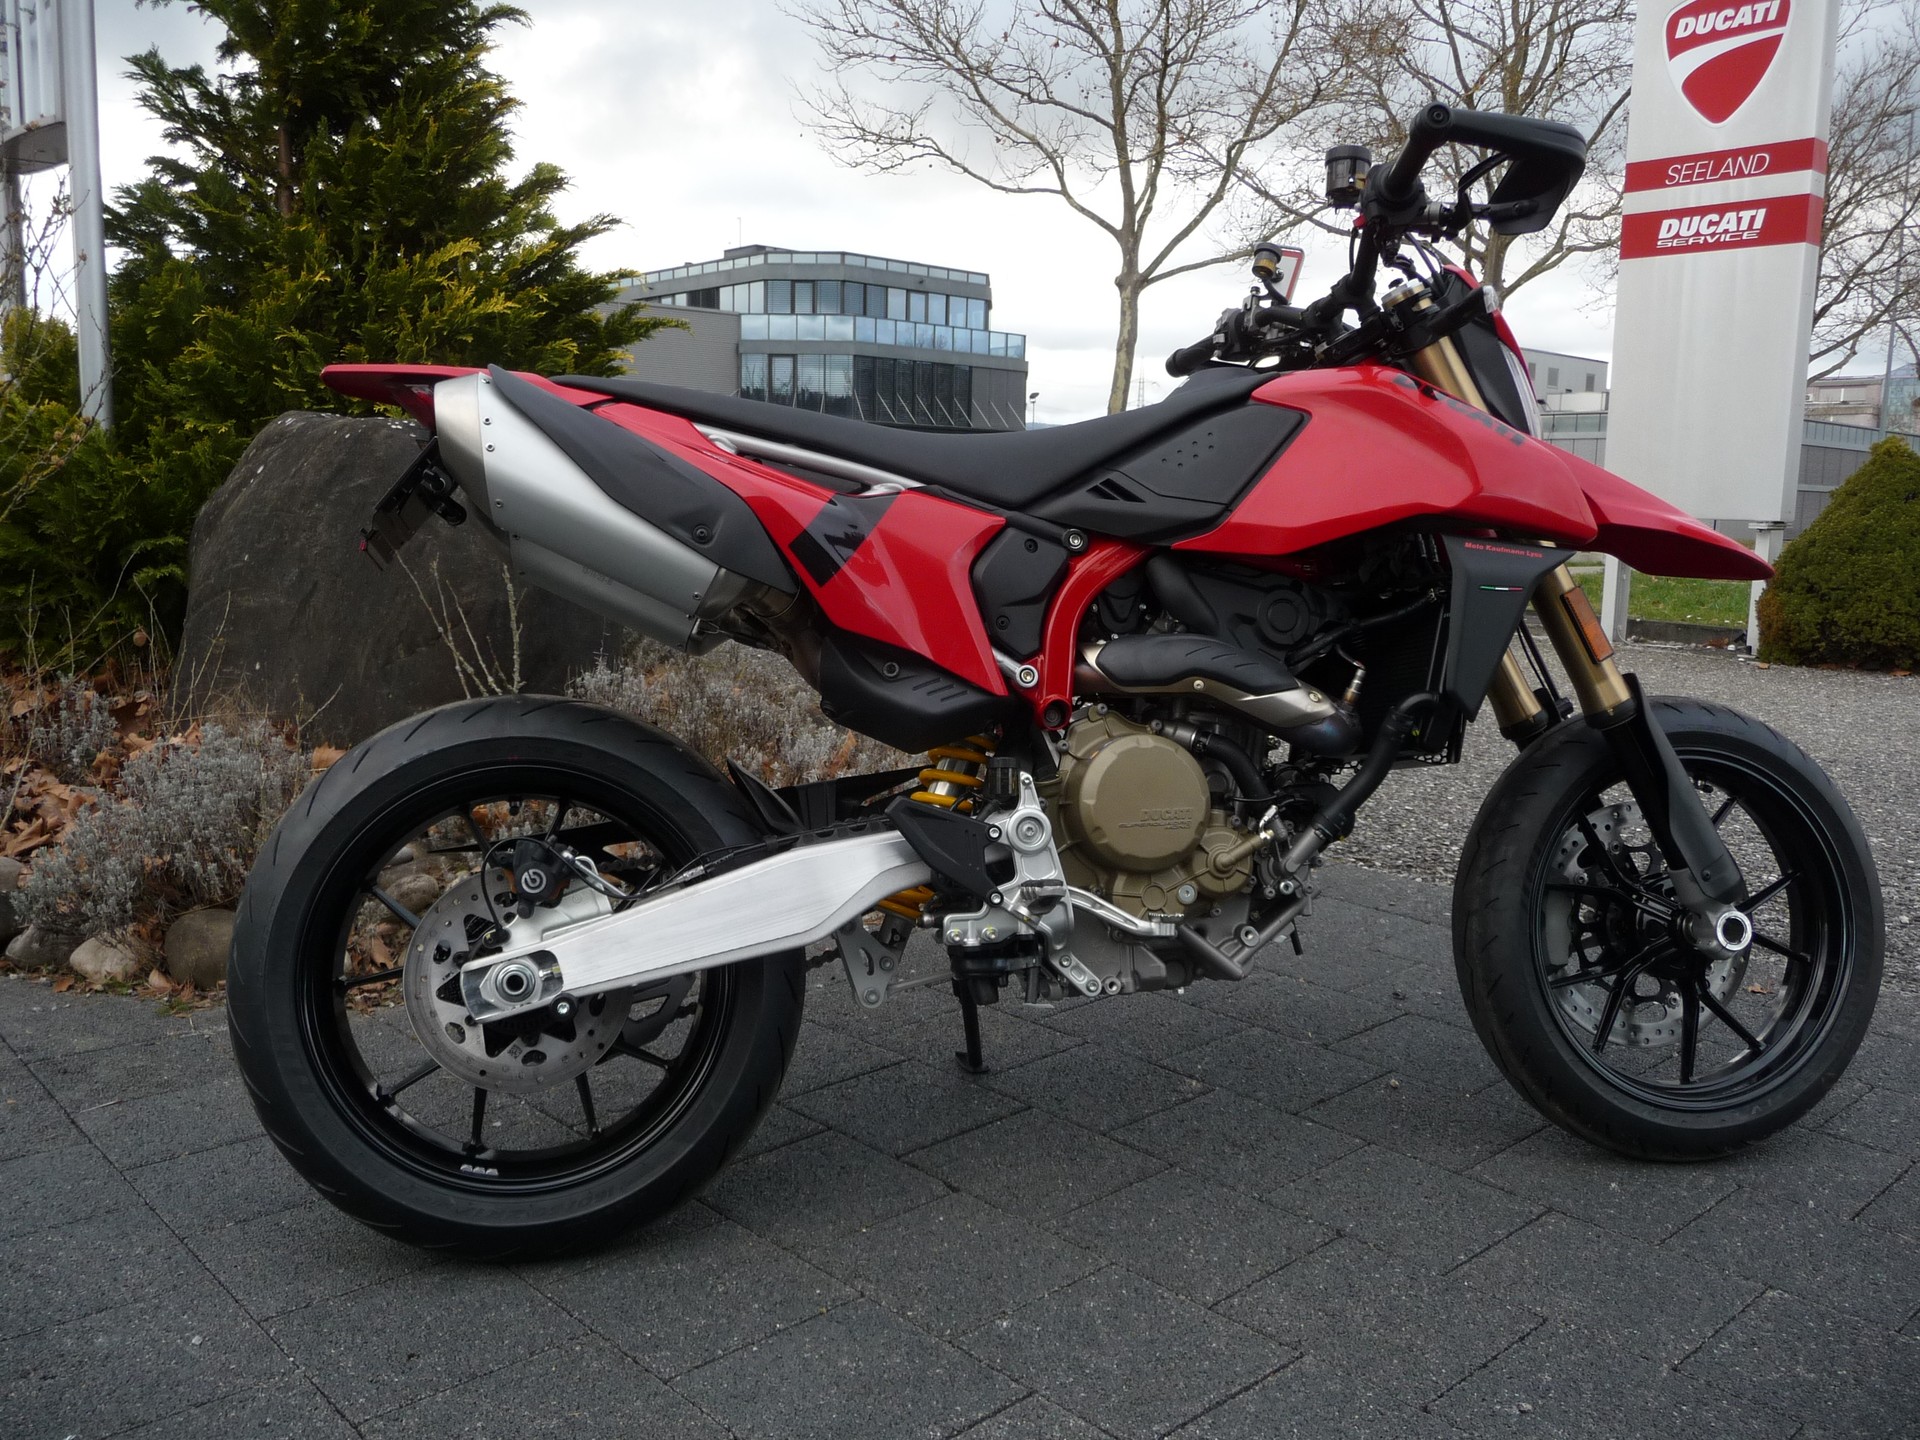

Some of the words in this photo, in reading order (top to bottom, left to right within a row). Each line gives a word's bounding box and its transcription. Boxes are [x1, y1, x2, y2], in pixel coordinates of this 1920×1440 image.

[1675, 0, 1780, 39] DUCATI
[1665, 153, 1770, 185] SEELAND
[1658, 208, 1767, 239] DUCATI
[1656, 230, 1760, 249] SERVICE
[1464, 542, 1484, 550] Moto
